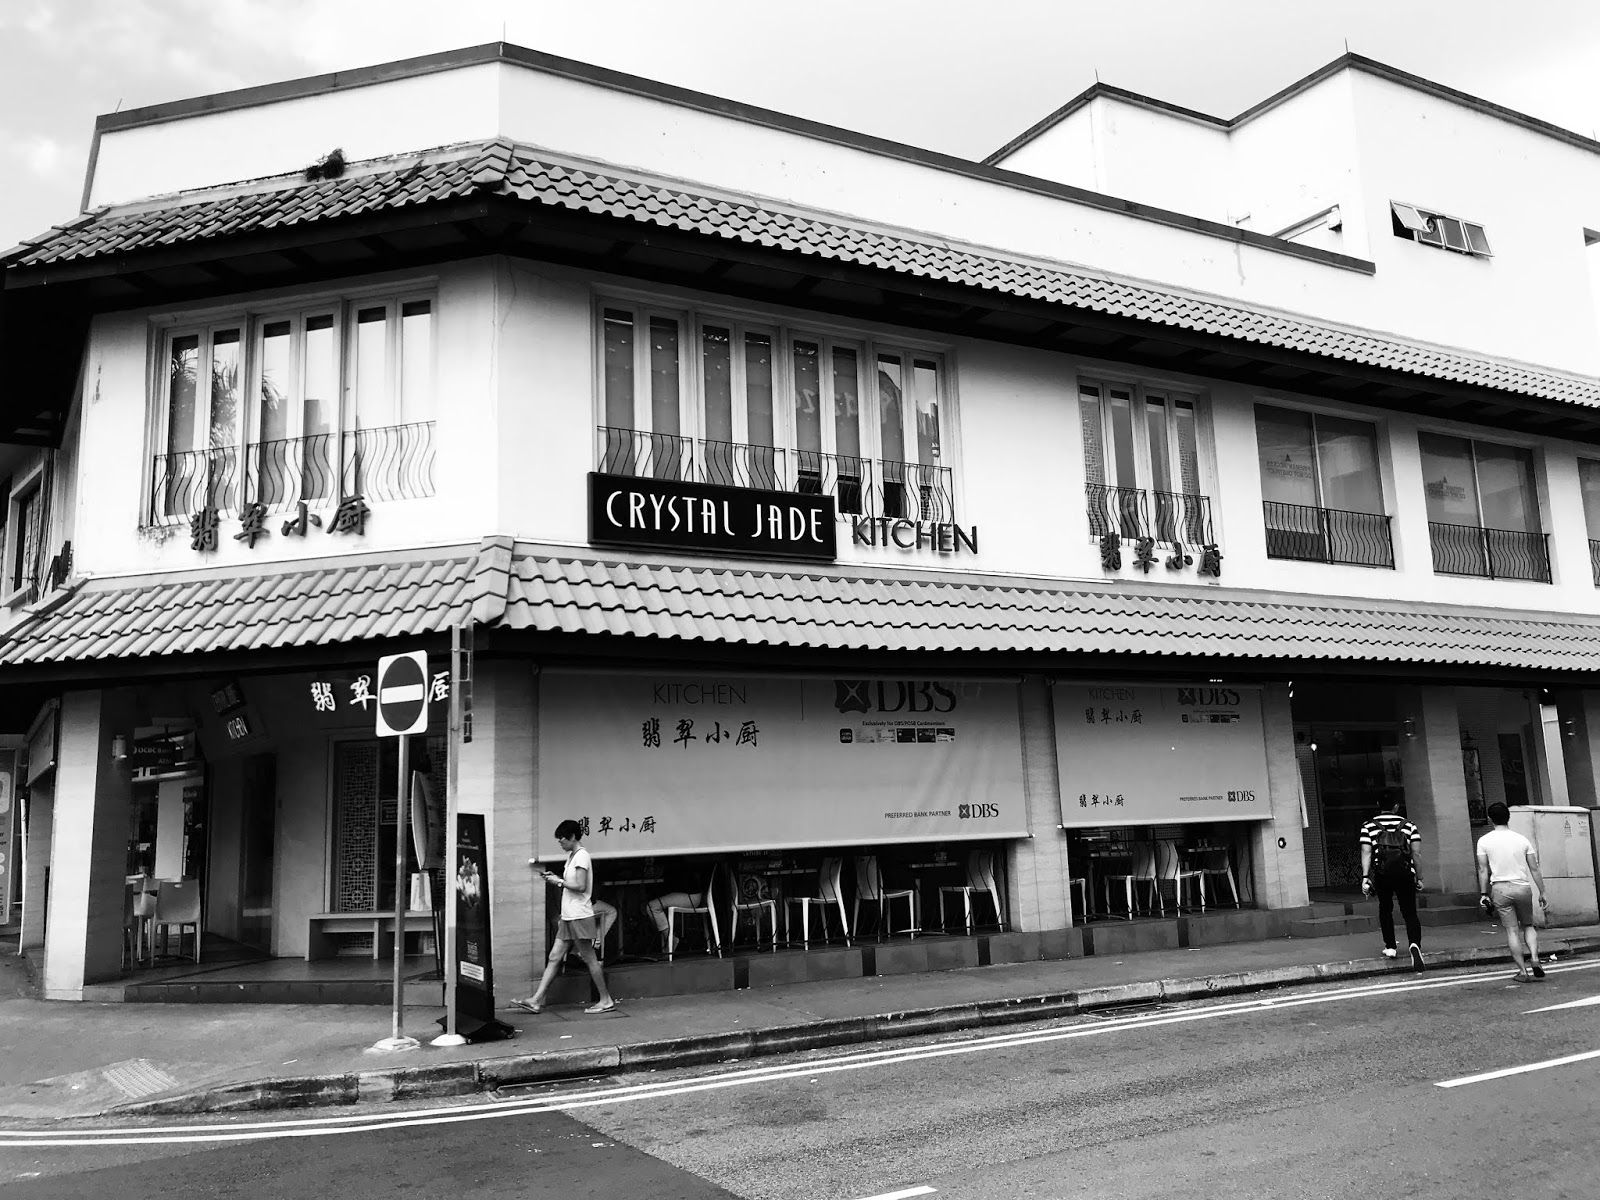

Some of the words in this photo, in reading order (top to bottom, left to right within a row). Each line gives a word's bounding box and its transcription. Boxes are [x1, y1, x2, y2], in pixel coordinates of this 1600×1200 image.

[190, 494, 371, 552] 翡翠小厨
[606, 490, 735, 536] CRYSTAL
[751, 503, 824, 543] JADE
[853, 516, 979, 555] KITCHEN
[1100, 531, 1224, 578] 翡翠小厨
[653, 683, 747, 705] KITCHEN
[876, 680, 957, 713] DBS
[1087, 687, 1136, 701] KITCHEN
[1200, 687, 1241, 706] DBS
[1085, 706, 1143, 725] 翡翠小厨
[641, 716, 760, 750] 翡翠小厨
[137, 746, 157, 754] OCBC
[1079, 793, 1125, 808] 翡翠小厨
[1236, 790, 1255, 802] DBS
[884, 811, 913, 819] PREFERRED
[971, 802, 999, 819] DBS
